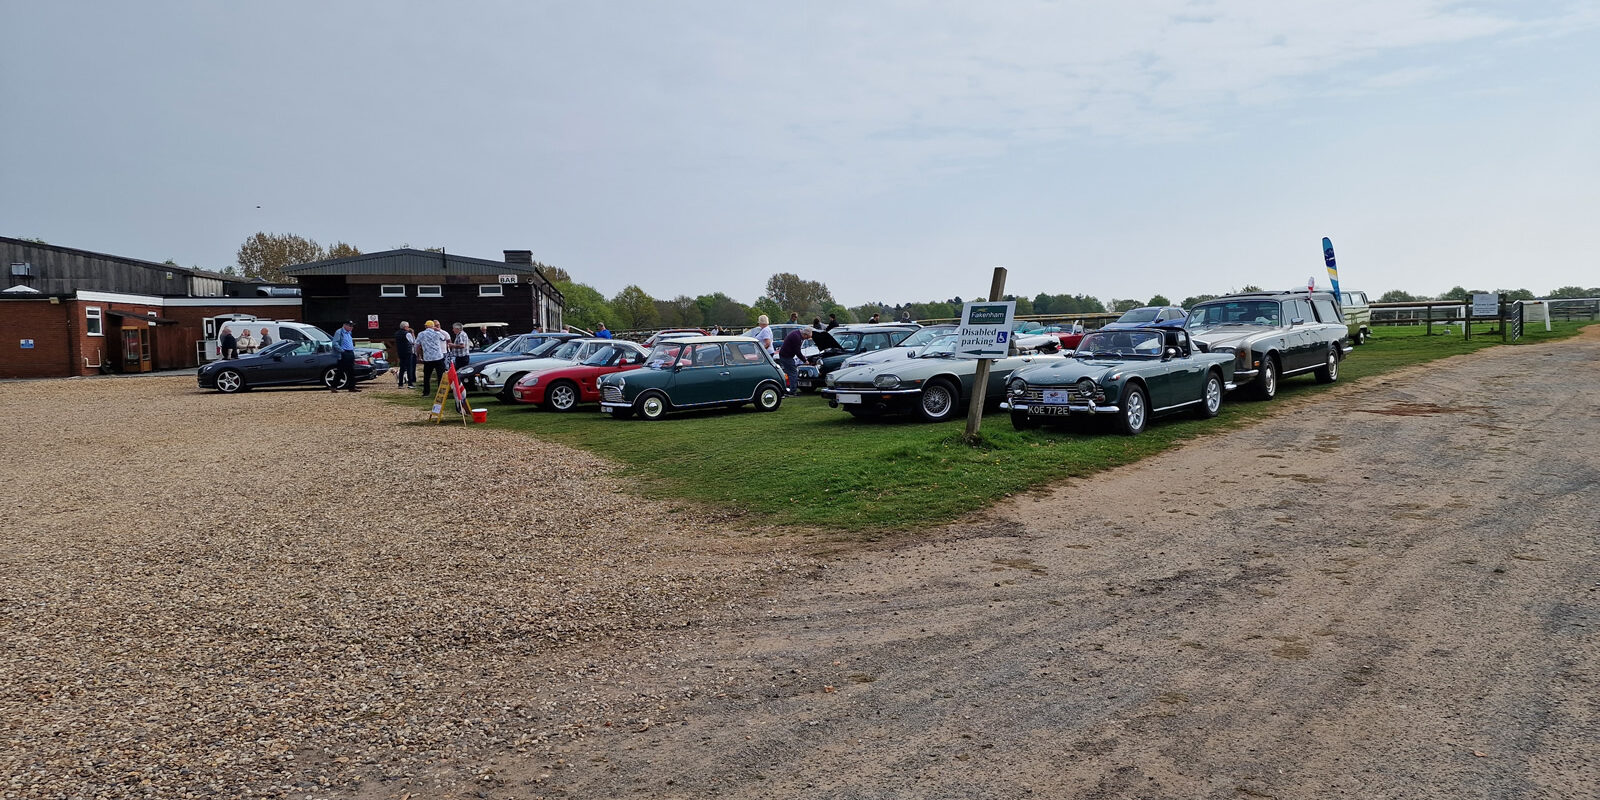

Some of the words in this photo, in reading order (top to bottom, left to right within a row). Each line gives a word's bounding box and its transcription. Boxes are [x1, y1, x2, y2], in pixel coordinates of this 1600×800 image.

[962, 328, 997, 336] Disabled
[961, 338, 994, 346] parking
[1028, 406, 1045, 414] KOE
[1046, 406, 1069, 414] 772E
